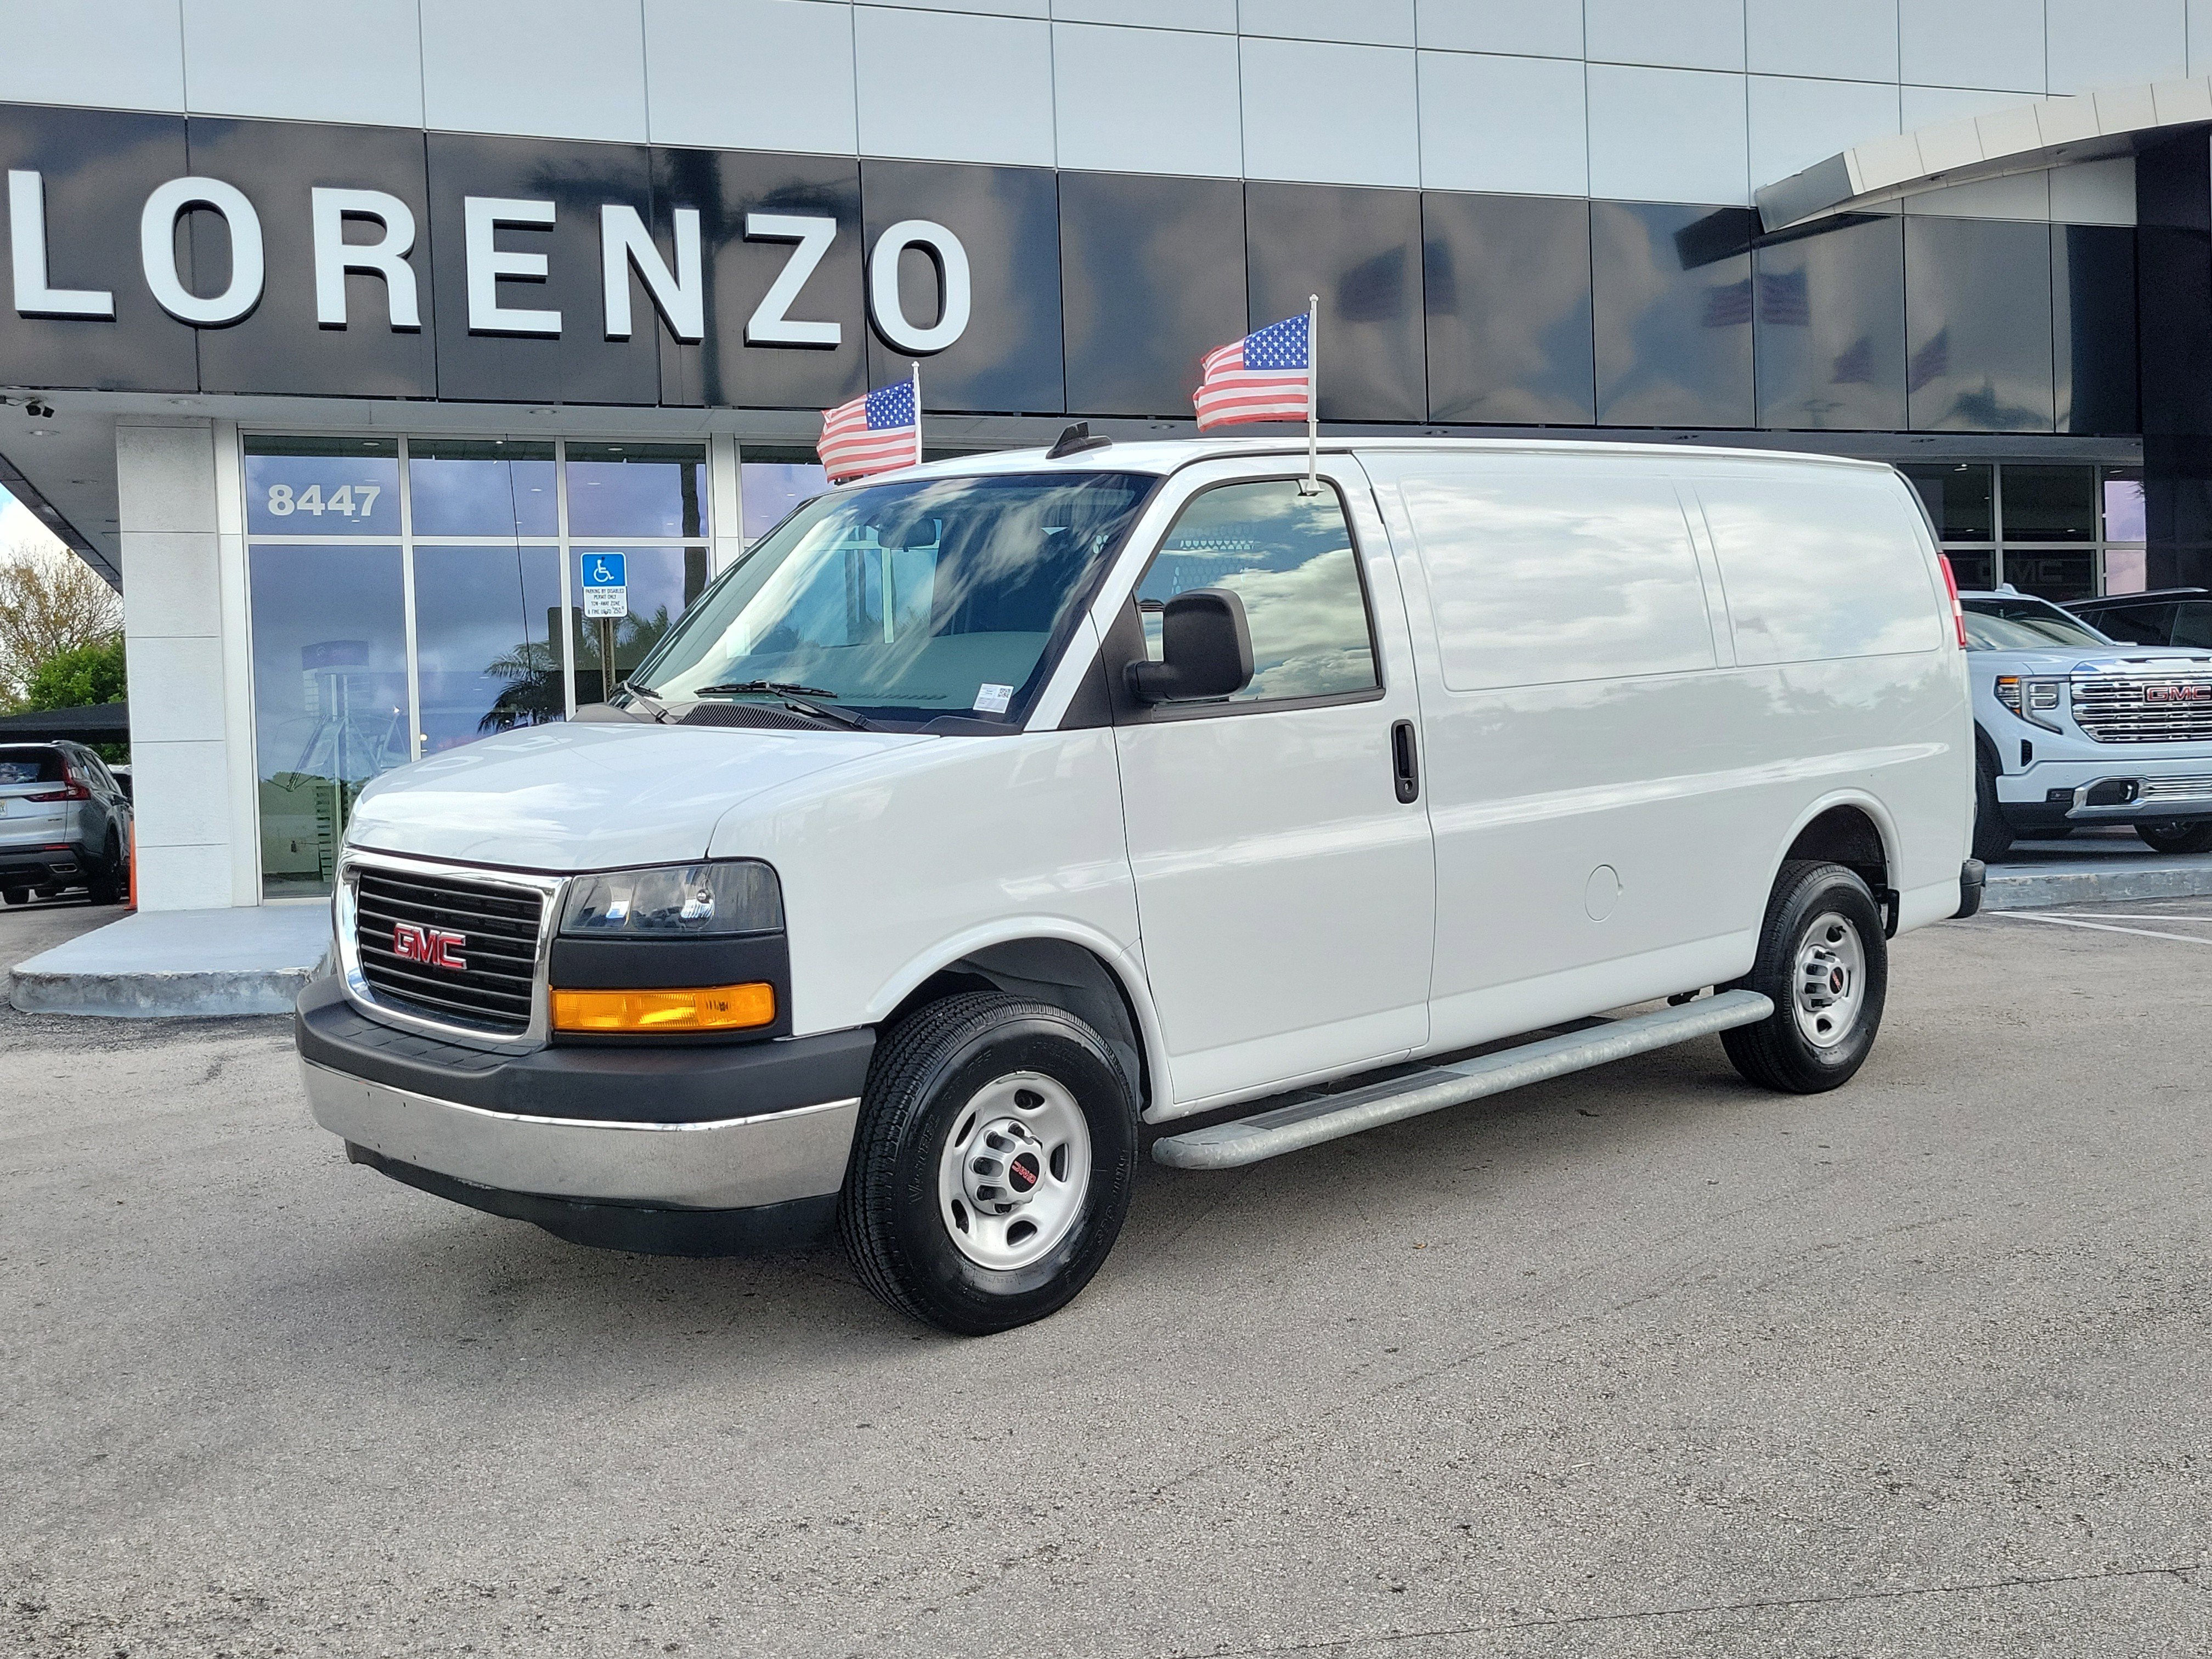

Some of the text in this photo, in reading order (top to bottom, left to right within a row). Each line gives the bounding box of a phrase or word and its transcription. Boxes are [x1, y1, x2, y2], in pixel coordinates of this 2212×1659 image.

[8, 169, 971, 354] LORENZO
[268, 484, 380, 516] 8447
[2147, 686, 2211, 701] GMC
[394, 923, 467, 969] GMC
[1012, 1160, 1036, 1184] GMC
